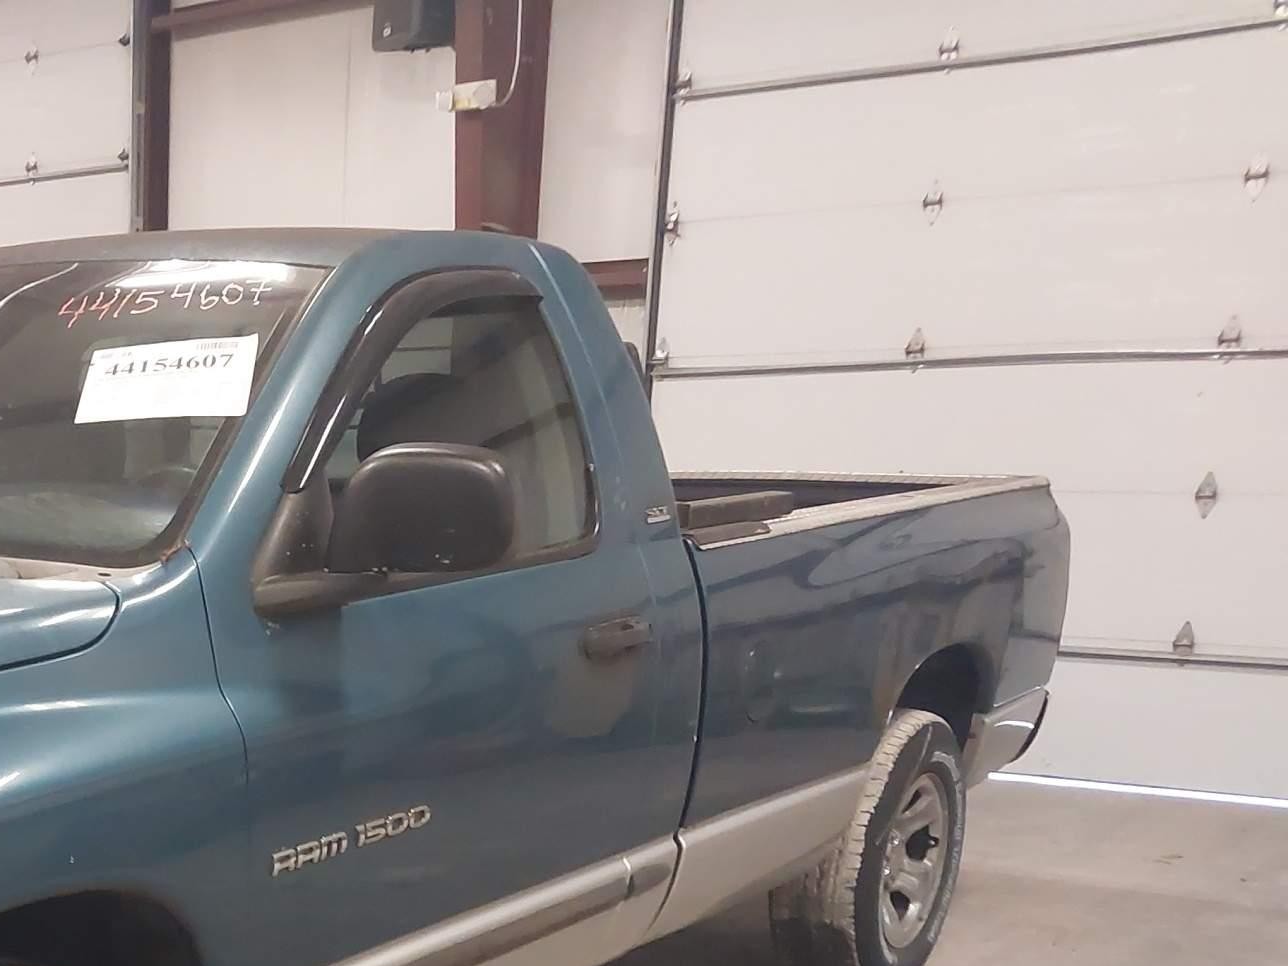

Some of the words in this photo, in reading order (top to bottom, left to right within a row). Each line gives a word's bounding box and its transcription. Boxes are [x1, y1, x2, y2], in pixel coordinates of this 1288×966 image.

[58, 279, 272, 328] 44154607
[105, 353, 234, 376] 44154607
[271, 831, 349, 877] RAM
[354, 804, 432, 848] 1500
